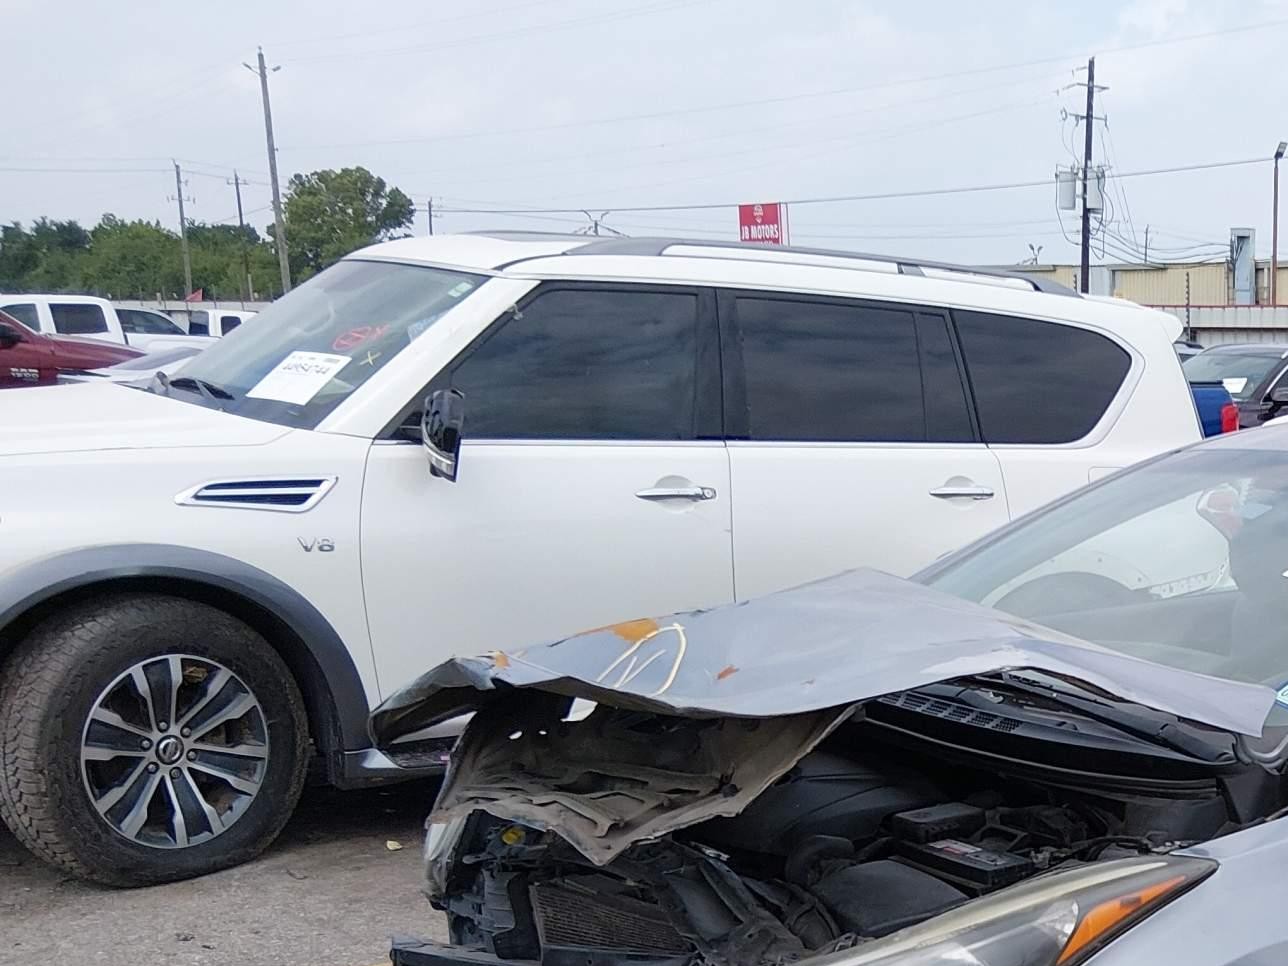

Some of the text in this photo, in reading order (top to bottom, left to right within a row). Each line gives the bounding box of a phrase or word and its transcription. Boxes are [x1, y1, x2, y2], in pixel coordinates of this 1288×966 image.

[741, 223, 779, 240] JB MOTORS
[297, 537, 335, 552] V8
